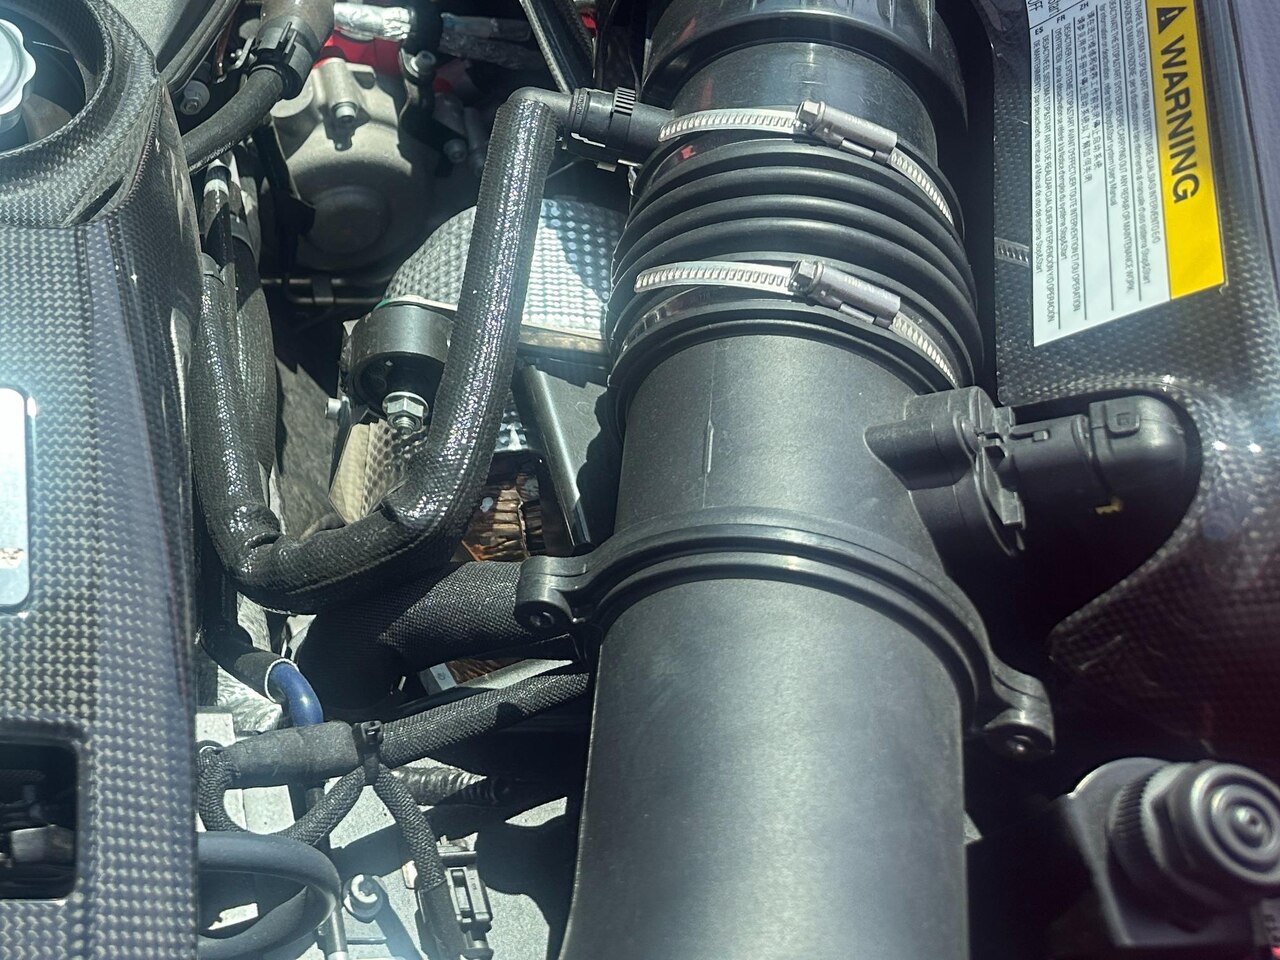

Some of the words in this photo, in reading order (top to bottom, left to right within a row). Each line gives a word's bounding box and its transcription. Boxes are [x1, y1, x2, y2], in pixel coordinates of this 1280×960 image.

[1079, 0, 1088, 11] ZH
[1056, 13, 1065, 23] FR
[1034, 25, 1043, 35] ES
[1158, 34, 1200, 204] WARNING
